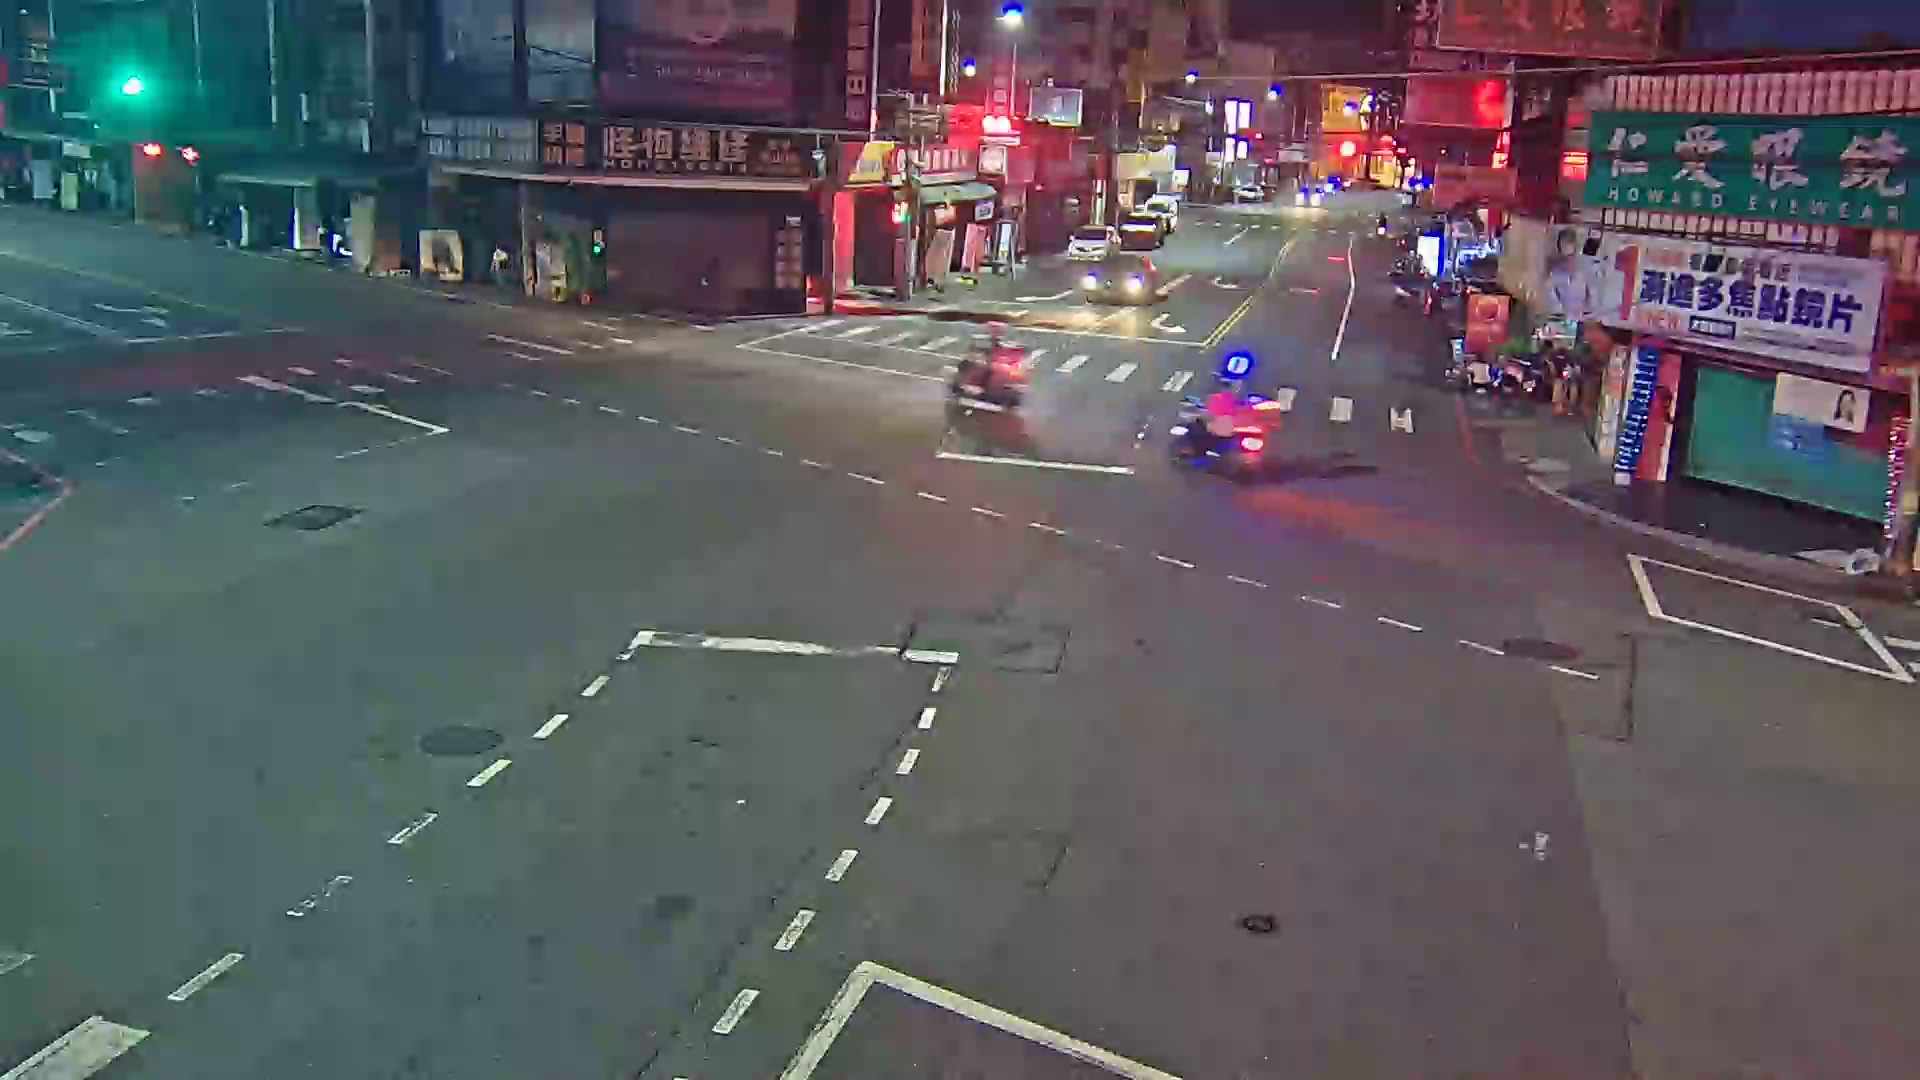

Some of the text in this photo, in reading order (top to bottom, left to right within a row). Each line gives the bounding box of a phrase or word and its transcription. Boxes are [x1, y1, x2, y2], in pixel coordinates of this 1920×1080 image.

[1607, 186, 1900, 223] HOWARD EYEWEAR
[1639, 269, 1863, 334] 漸進多焦點鏡片
